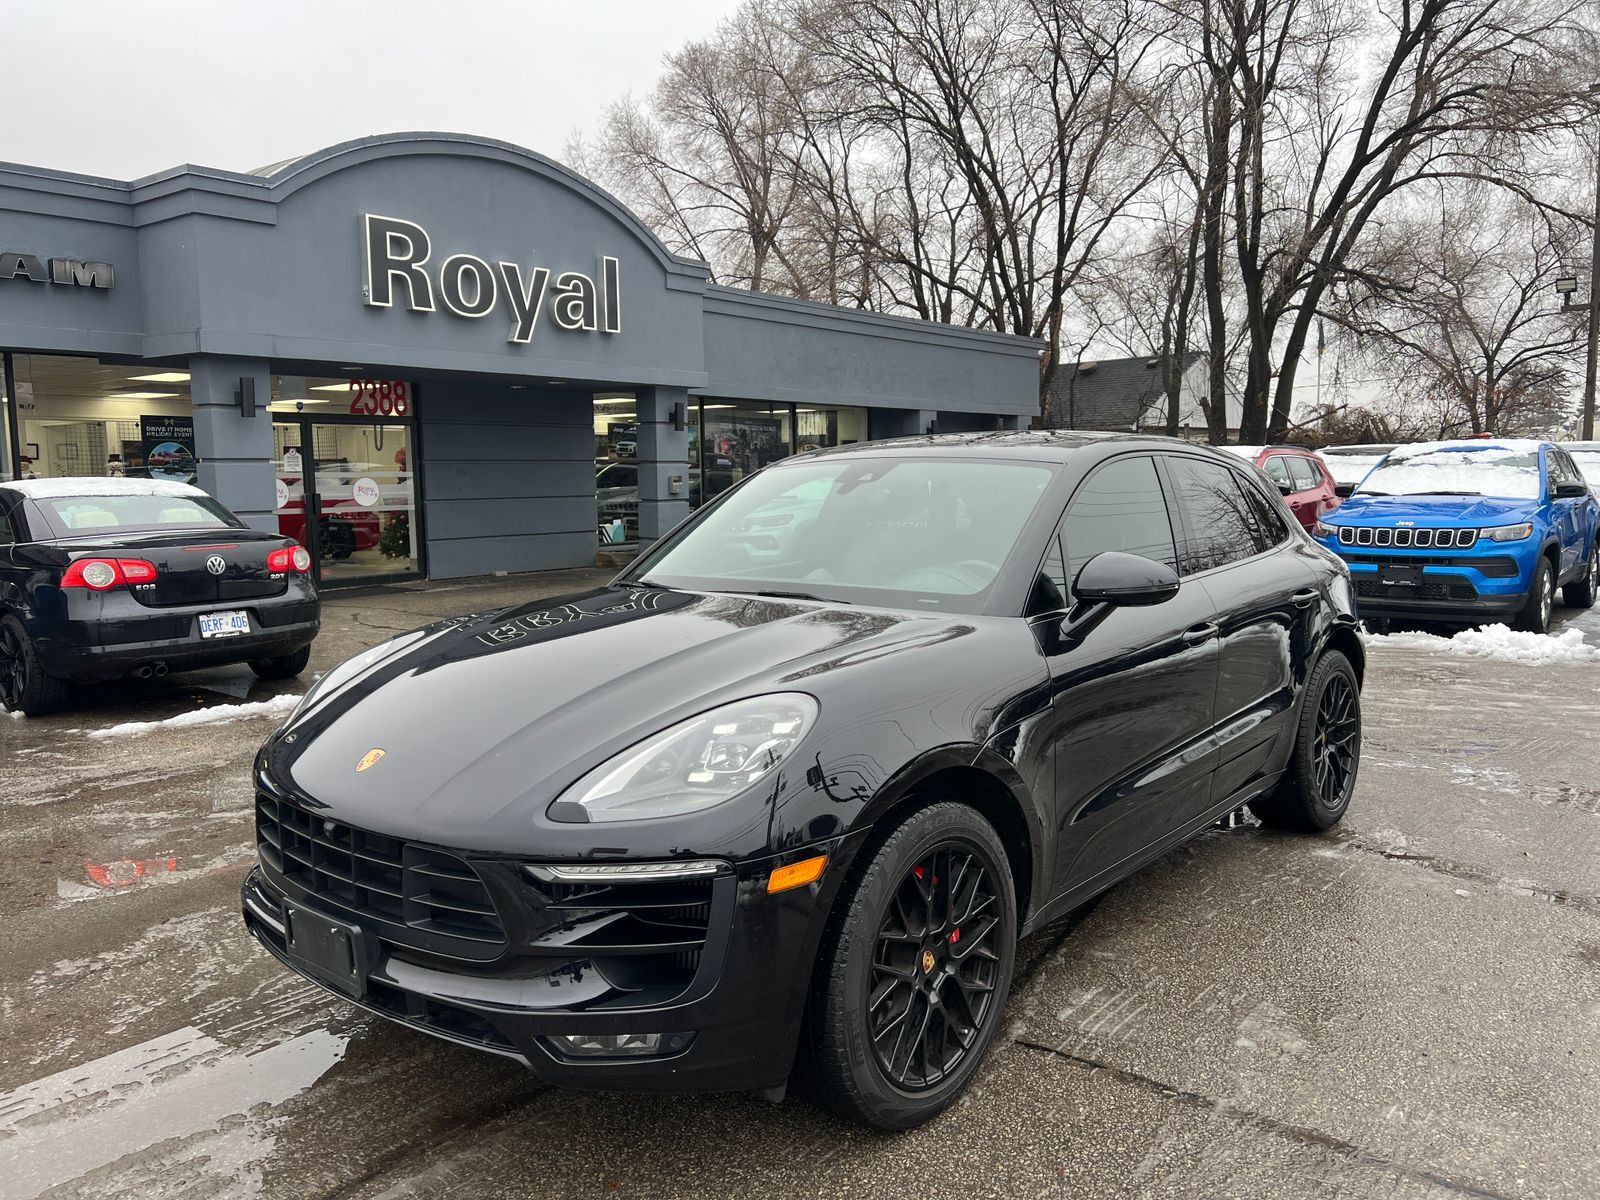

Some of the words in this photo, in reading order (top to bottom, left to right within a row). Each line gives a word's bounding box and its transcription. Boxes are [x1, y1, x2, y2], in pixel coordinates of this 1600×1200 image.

[361, 213, 621, 343] Royal
[350, 378, 408, 416] 2388
[135, 583, 156, 591] EOS
[231, 615, 248, 630] 406
